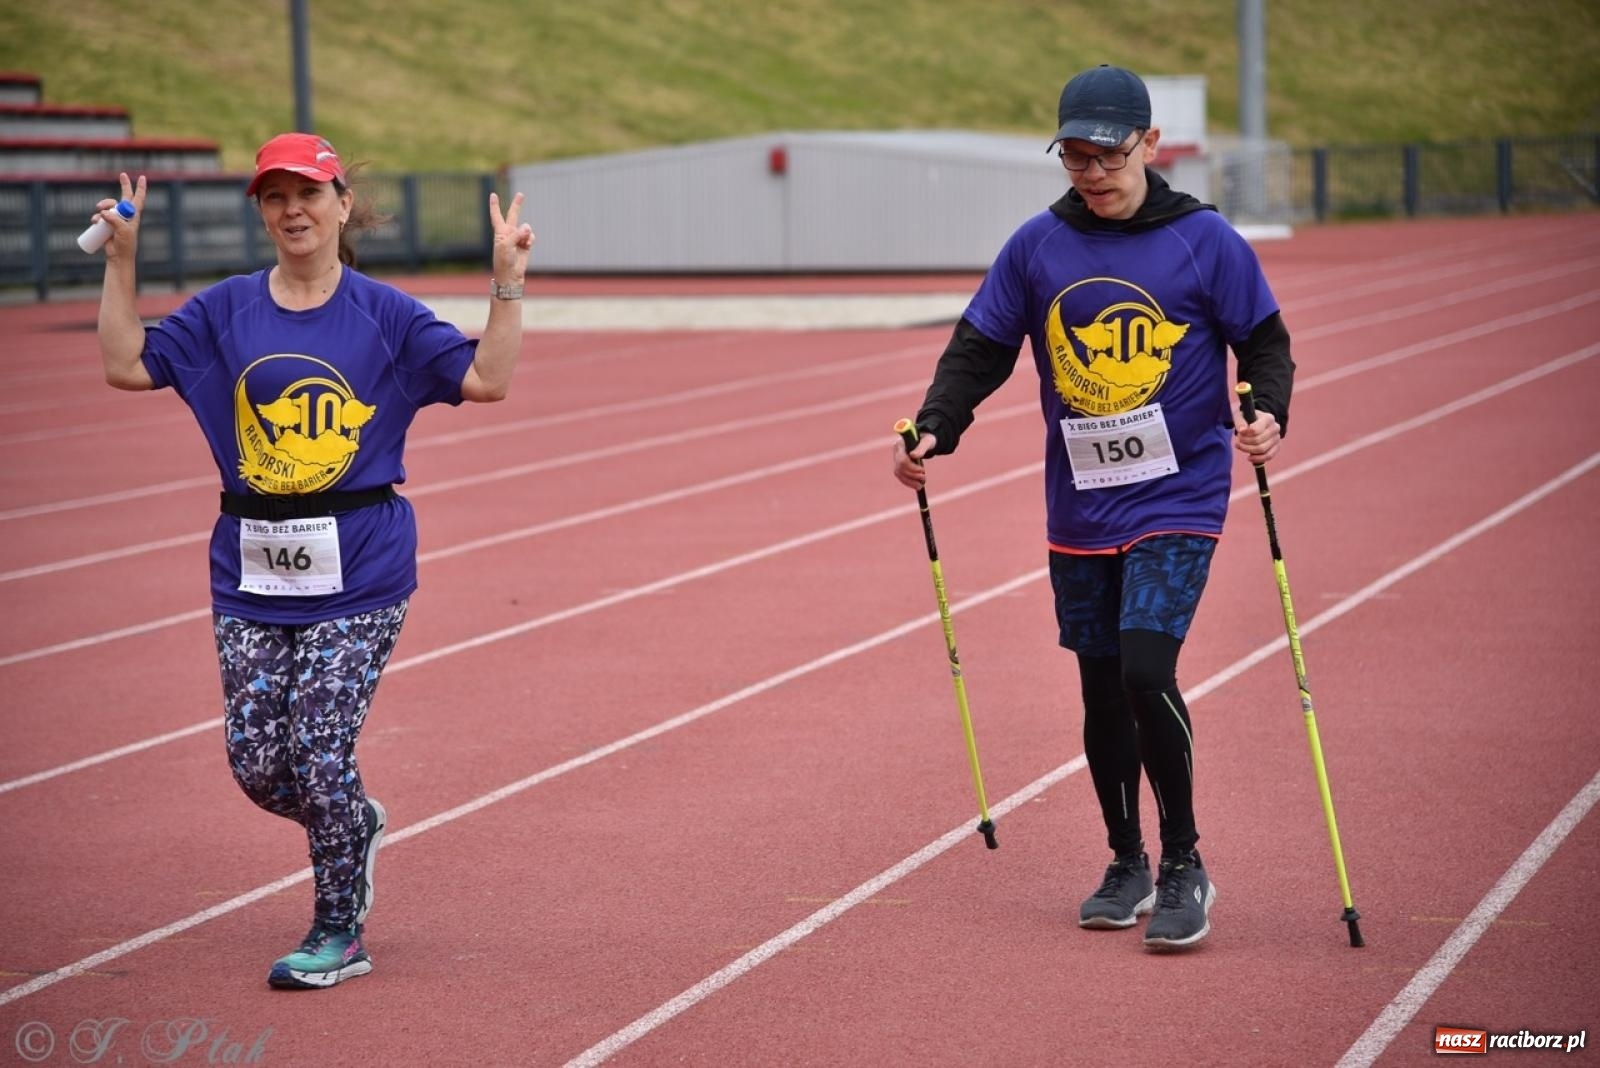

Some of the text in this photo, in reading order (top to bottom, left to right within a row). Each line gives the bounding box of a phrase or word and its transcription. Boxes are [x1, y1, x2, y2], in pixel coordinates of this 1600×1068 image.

[1105, 316, 1153, 363] 10
[1056, 345, 1110, 401] RACIBORSKI
[293, 392, 342, 439] 10
[1077, 422, 1098, 431] BIEG
[1100, 420, 1117, 429] BEZ
[1120, 410, 1154, 426] BARIER
[245, 424, 296, 479] RACORSKI
[1092, 436, 1144, 464] 150
[272, 525, 289, 534] BEZ
[292, 523, 328, 533] BARIER
[263, 546, 312, 571] 146
